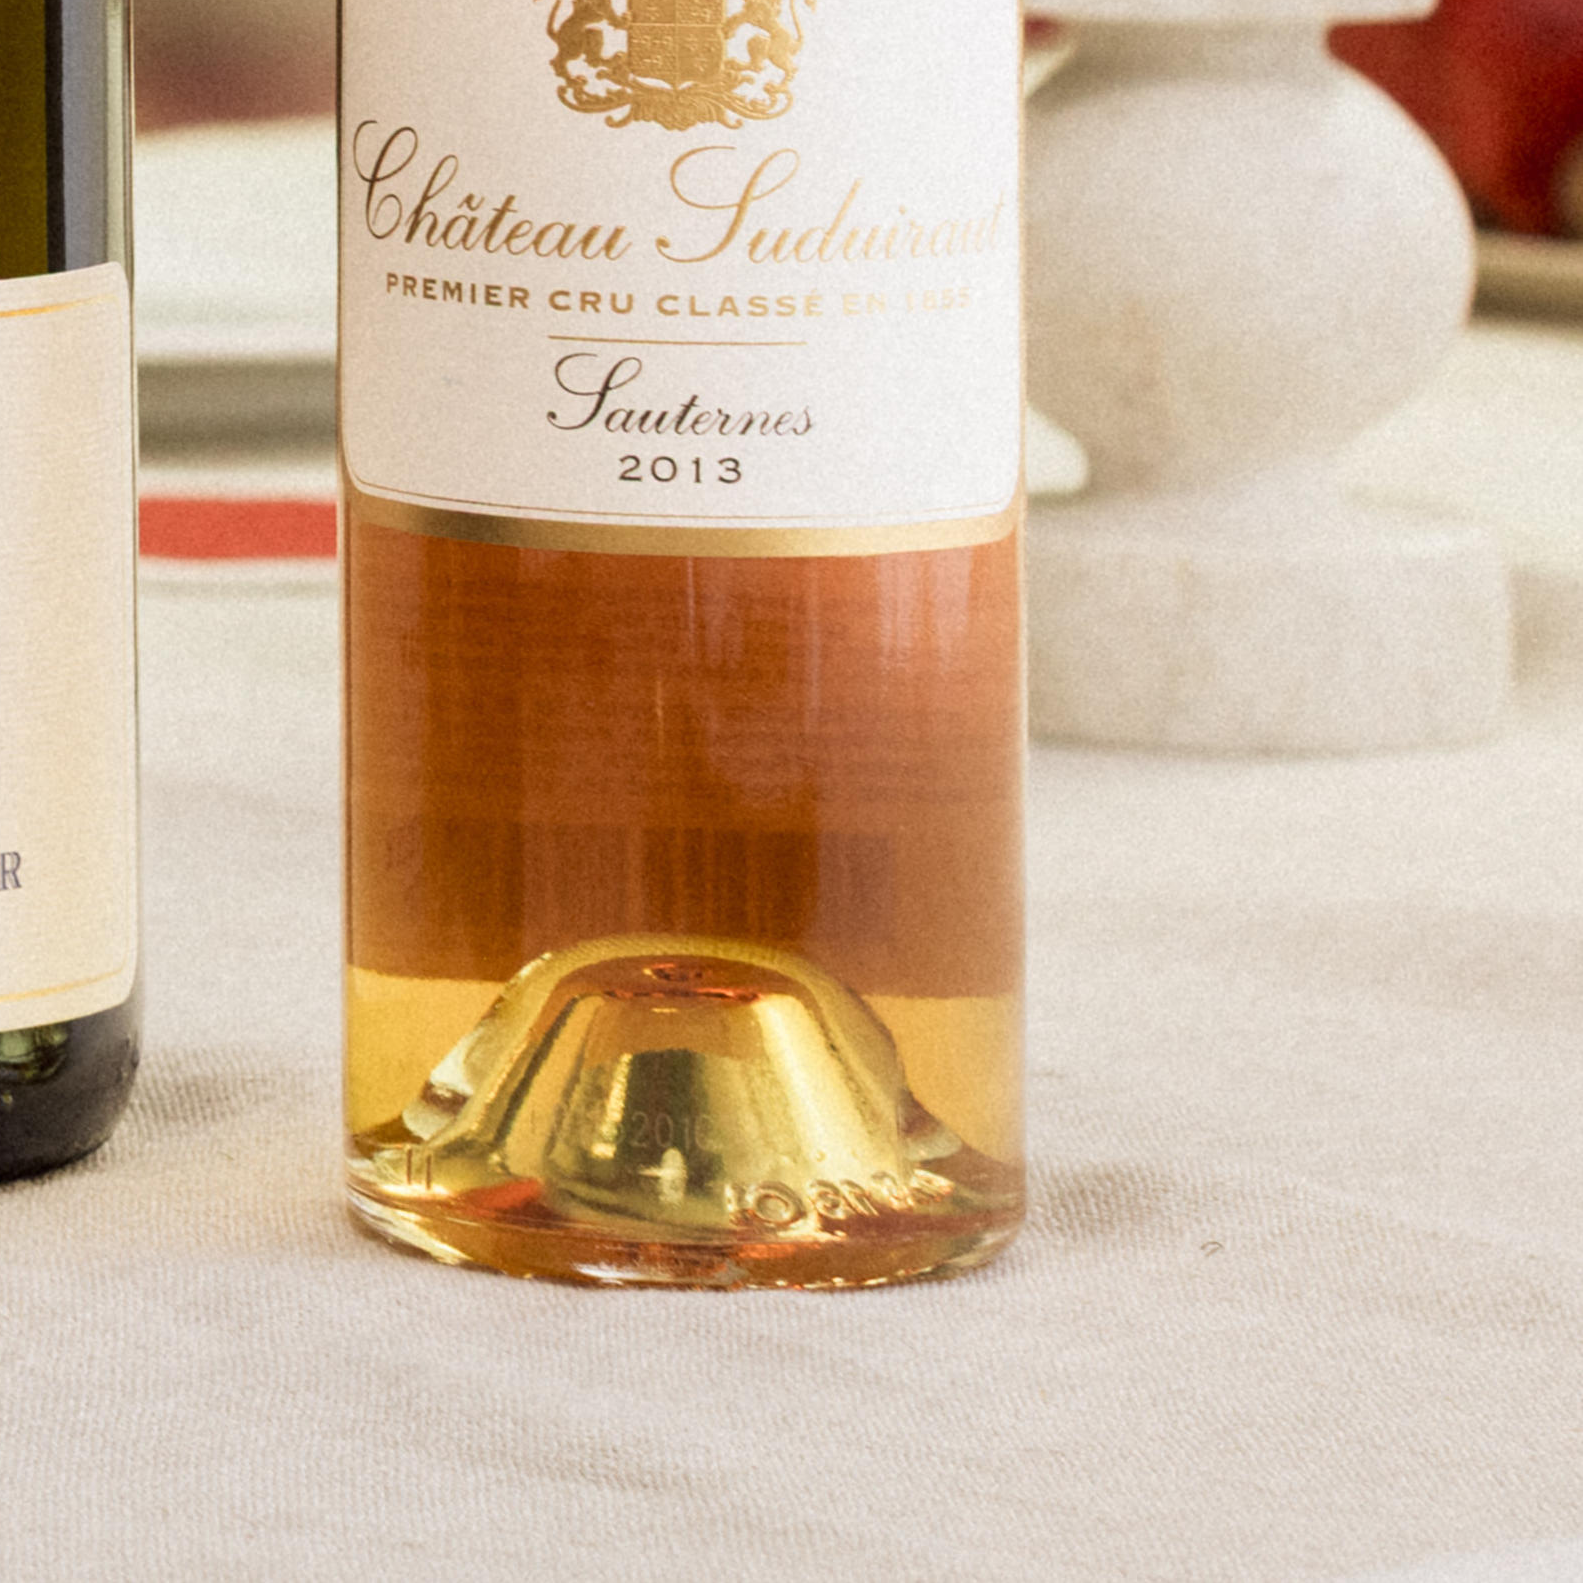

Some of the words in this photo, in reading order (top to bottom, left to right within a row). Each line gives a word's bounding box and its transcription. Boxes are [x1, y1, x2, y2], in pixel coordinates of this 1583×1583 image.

[655, 145, 1006, 264] Suduiraut
[385, 271, 530, 309] PREMIER
[548, 289, 634, 314] CRU
[656, 289, 824, 318] CLASSÉ
[842, 291, 888, 316] EN
[546, 352, 813, 438] Sauternes
[618, 455, 743, 485] 2013
